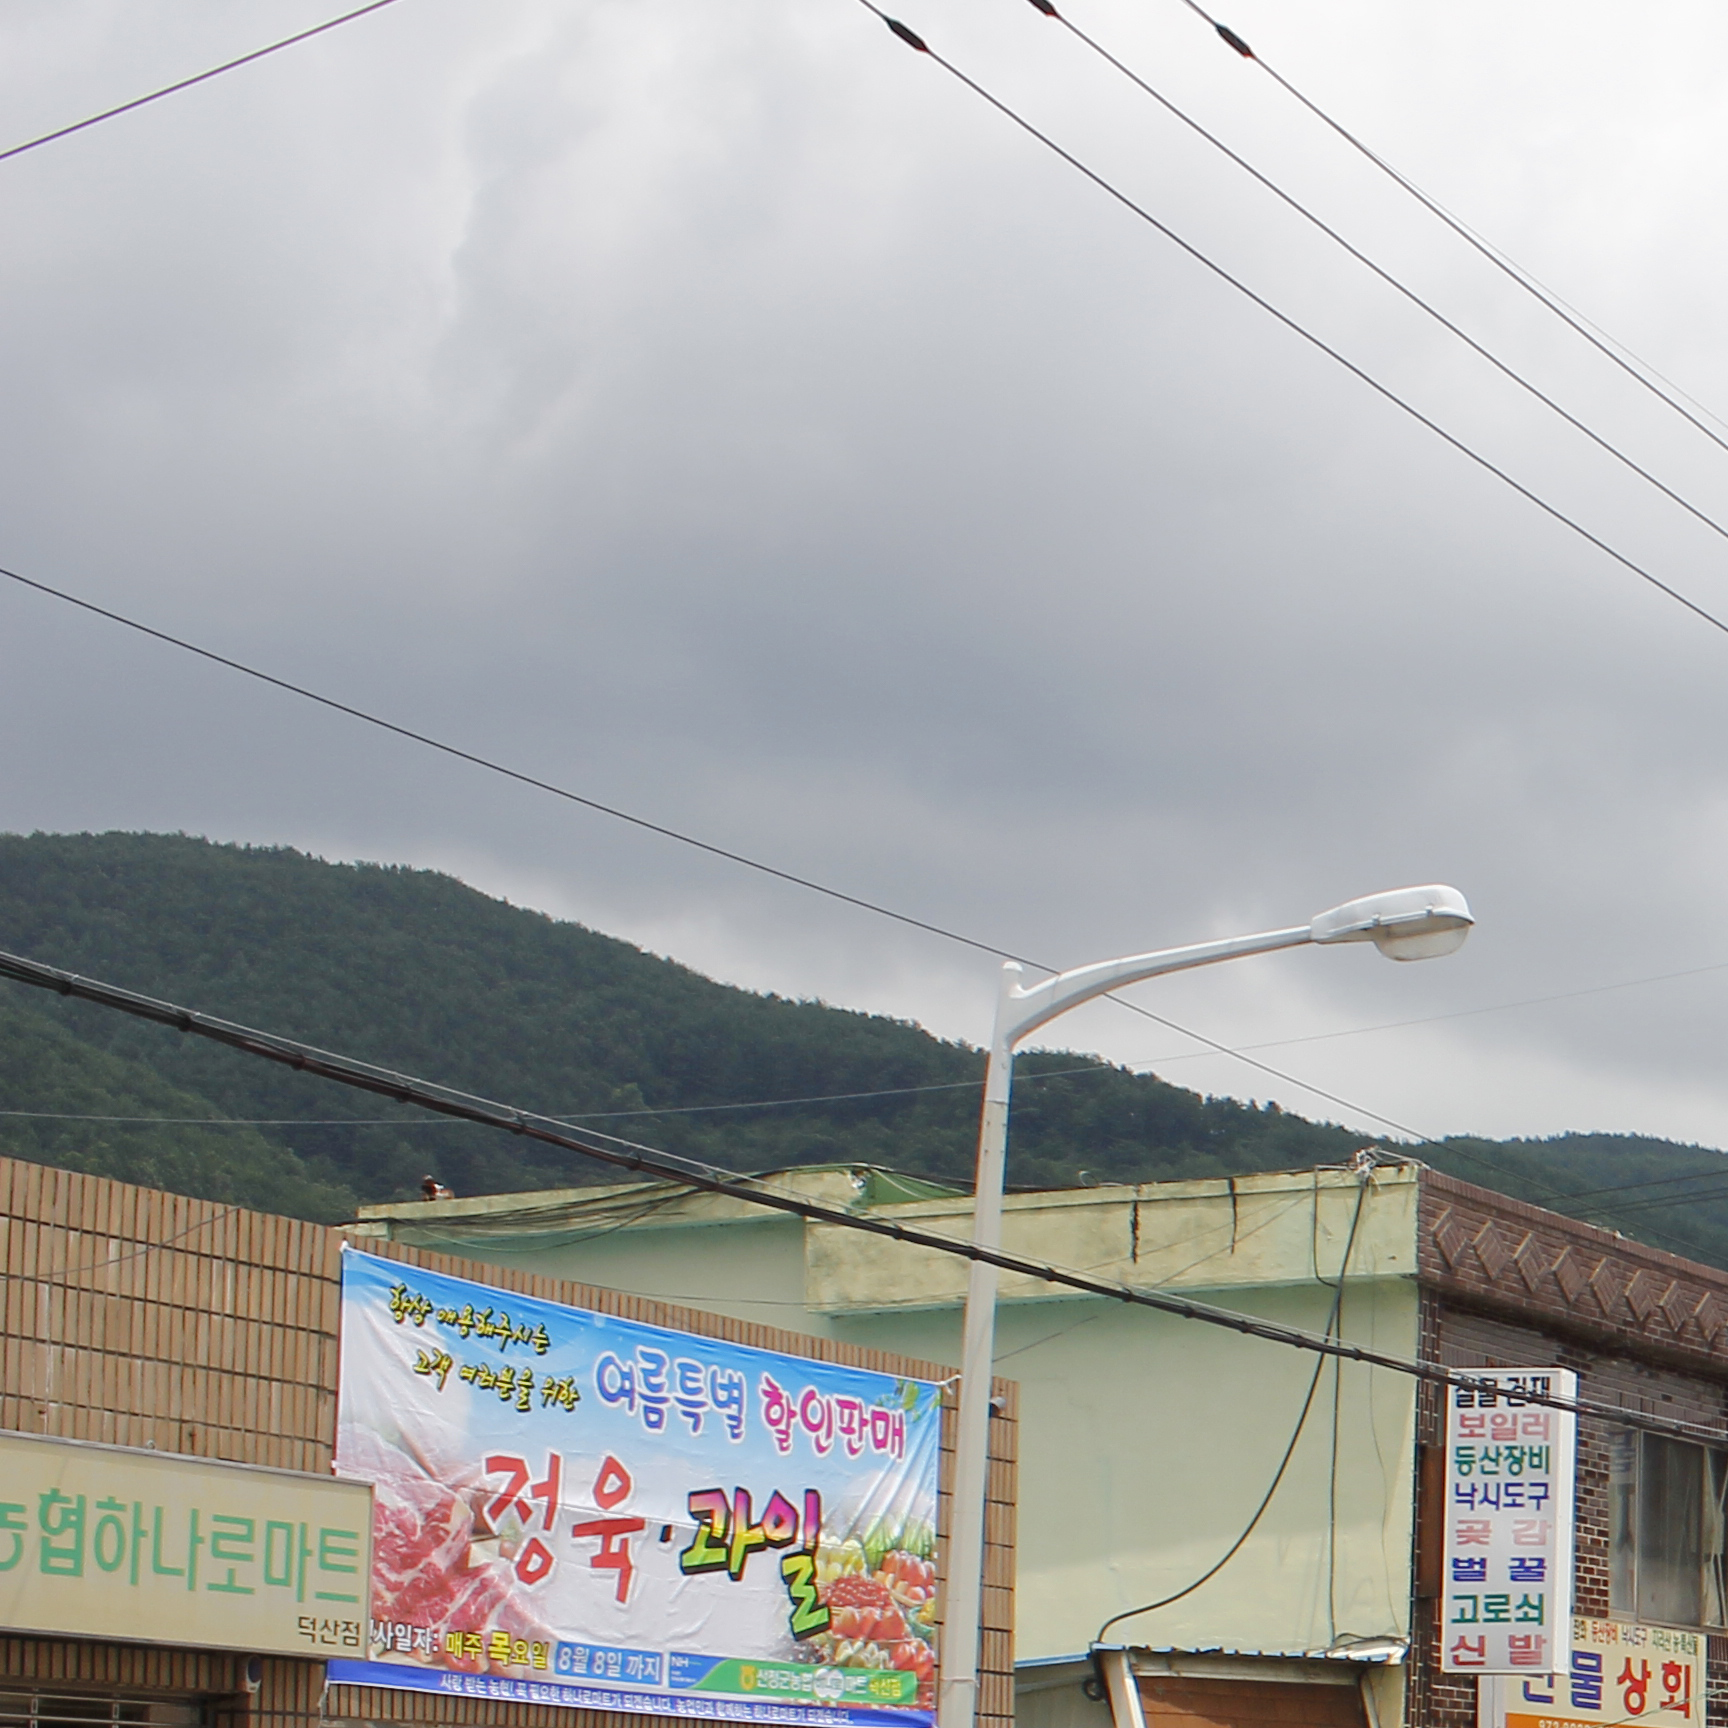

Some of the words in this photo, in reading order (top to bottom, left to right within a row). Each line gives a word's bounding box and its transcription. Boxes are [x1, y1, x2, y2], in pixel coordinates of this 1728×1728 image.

[388, 1283, 433, 1326] 항상
[437, 1303, 551, 1355] 애용해주시는
[413, 1348, 454, 1392] 고객
[459, 1364, 534, 1413] 여러분을
[540, 1375, 581, 1413] 위한
[594, 1346, 747, 1443] 여름특별
[760, 1372, 905, 1460] 할인판매
[1458, 1413, 1550, 1441] 보일러
[1455, 1445, 1550, 1476] 등산장비
[1452, 1556, 1547, 1583] 벌꿀
[1450, 1593, 1545, 1626] 고로쇠
[298, 1616, 361, 1647] 덕산점
[1591, 1620, 1618, 1645] 등산장비
[370, 1620, 439, 1656] 사일자:
[446, 1631, 483, 1661] 매주
[488, 1630, 549, 1671] 목요일
[557, 1646, 588, 1675] 8월
[593, 1650, 622, 1678] 8일
[625, 1653, 660, 1682] 까지
[671, 1656, 689, 1668] NH
[1449, 1634, 1547, 1667] 신발
[1617, 1656, 1691, 1719] 상회
